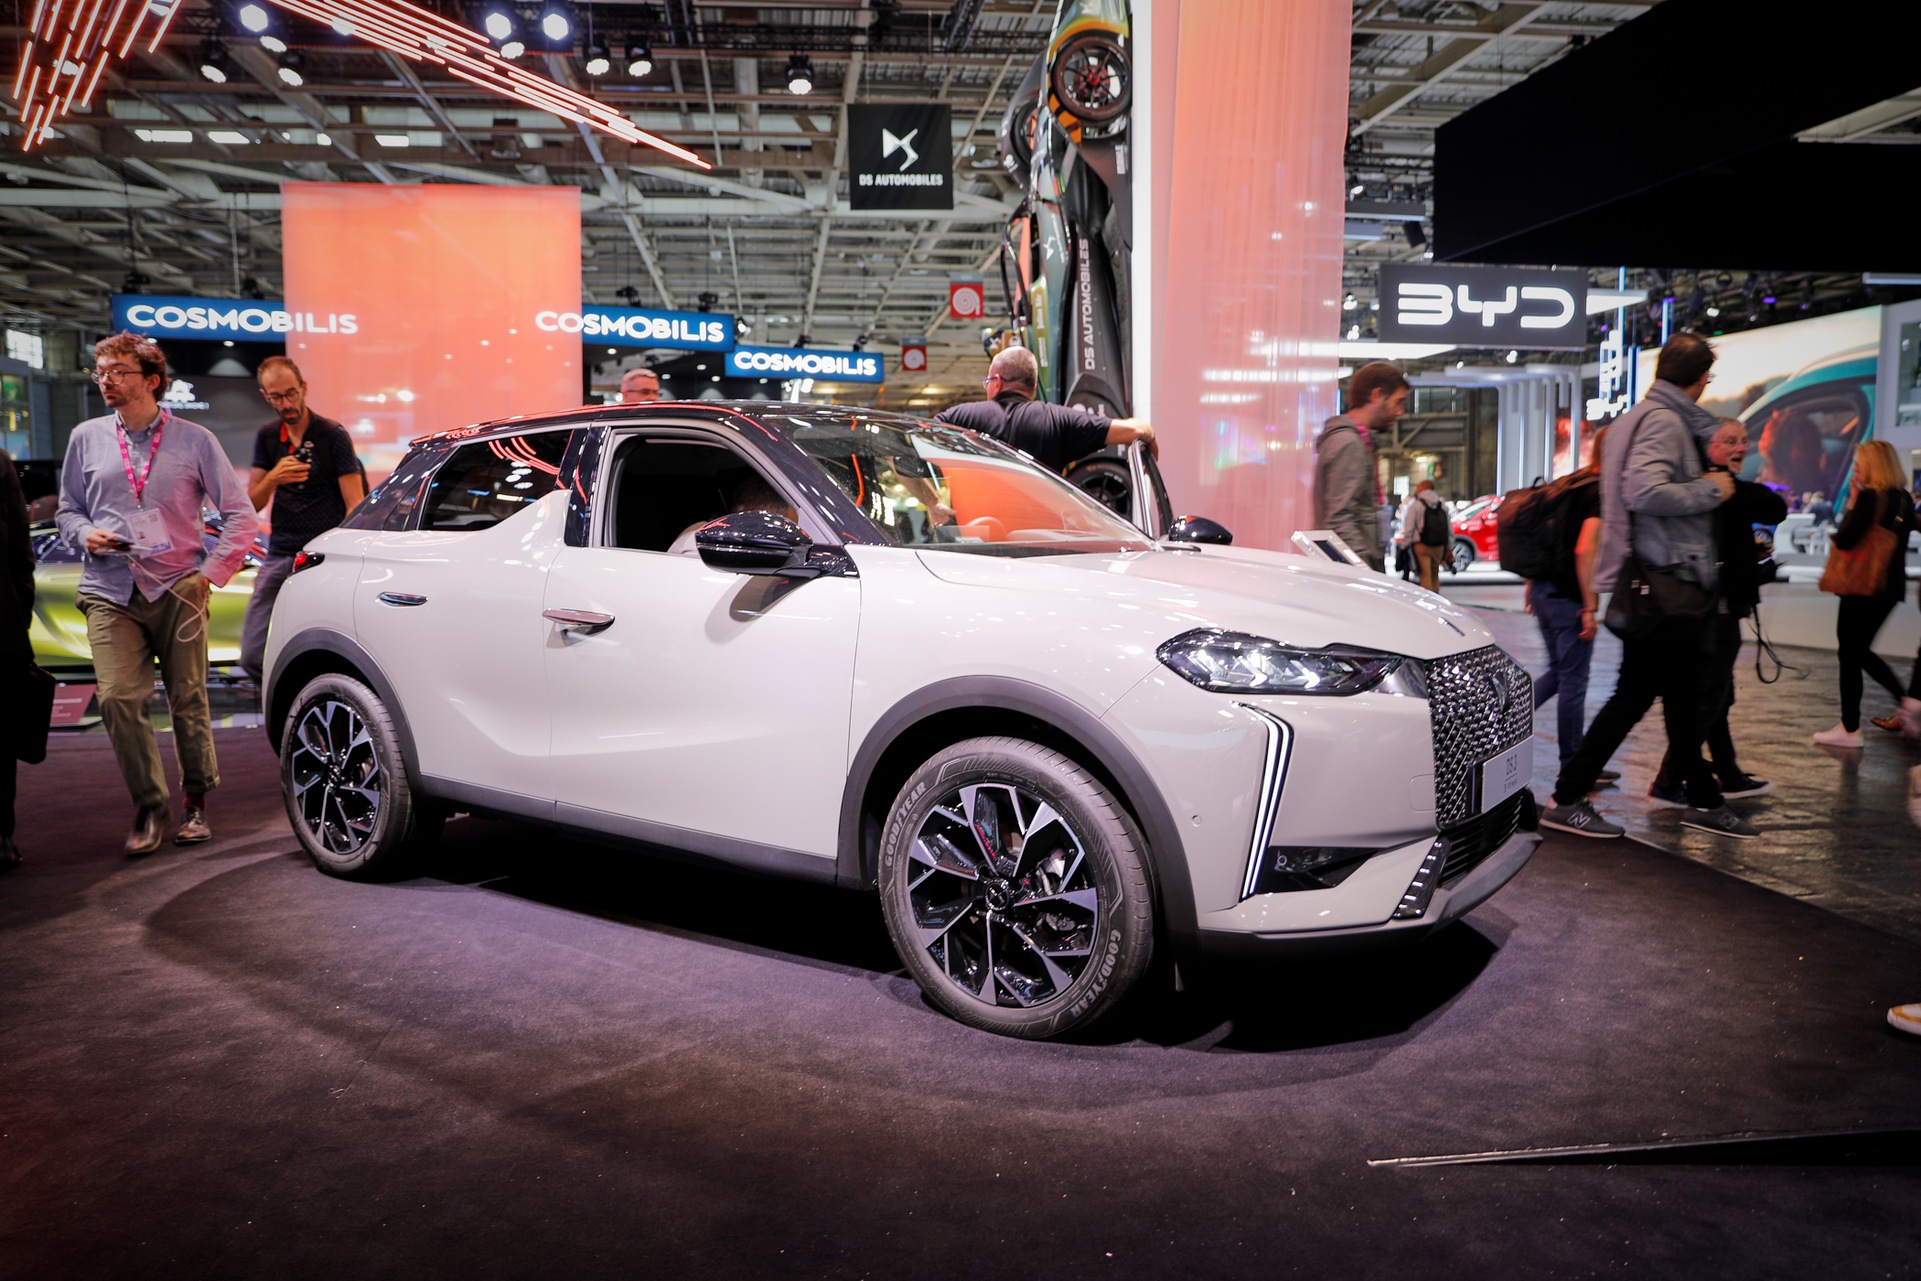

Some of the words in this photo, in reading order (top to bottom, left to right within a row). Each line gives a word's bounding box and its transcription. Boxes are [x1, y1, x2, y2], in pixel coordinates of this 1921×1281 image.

[859, 174, 873, 186] DS
[875, 174, 943, 186] AUTOMOBILES
[1079, 238, 1095, 345] AUTOMOBILES
[1398, 283, 1575, 328] BYD
[126, 304, 358, 334] COSMOBILIS
[535, 311, 724, 342] COSMOBILIS
[734, 351, 876, 376] COSMOBILIS
[1084, 350, 1095, 370] DS
[885, 782, 926, 866] GOODYEAR
[1070, 929, 1121, 1017] GOODYEAR
